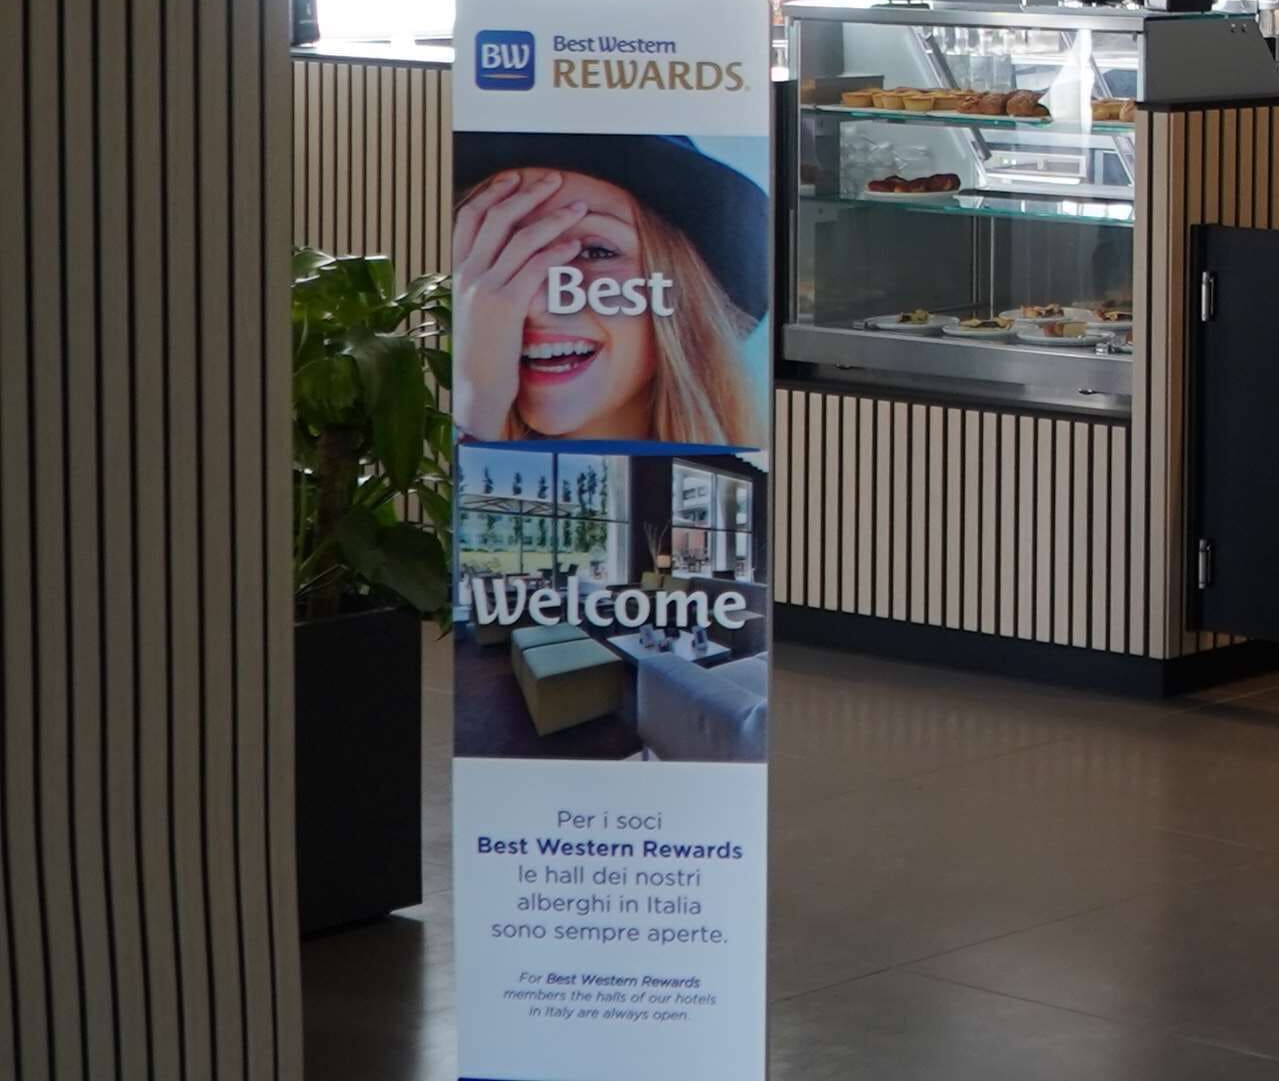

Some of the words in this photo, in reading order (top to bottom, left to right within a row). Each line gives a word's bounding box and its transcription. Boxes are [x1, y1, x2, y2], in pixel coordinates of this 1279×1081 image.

[552, 35, 595, 53] Best
[597, 36, 677, 54] Western
[481, 43, 530, 70] BW
[546, 265, 675, 317] Best
[470, 575, 748, 630] Welcome
[557, 810, 596, 829] Per
[603, 811, 609, 829] i
[617, 811, 662, 831] soci
[478, 836, 528, 855] Best
[536, 838, 633, 857] Western
[643, 840, 743, 860] Rewards
[518, 865, 537, 884] le
[545, 865, 584, 885] hall
[593, 867, 627, 886] dei
[636, 868, 701, 887] nostri
[517, 893, 610, 916] alberghi
[620, 896, 639, 914] in
[647, 896, 702, 916] Italia
[491, 923, 546, 940] sono
[554, 925, 640, 945] sempre
[648, 926, 728, 946] aperte.
[519, 972, 543, 985] For
[546, 973, 577, 986] Best
[581, 973, 638, 987] Western
[641, 975, 701, 989] Rewards
[503, 989, 566, 1002] members
[571, 991, 592, 1002] the
[596, 991, 627, 1003] halls
[630, 992, 646, 1004] of
[648, 995, 672, 1005] our
[675, 994, 717, 1006] hotels
[528, 1006, 541, 1017] in
[545, 1007, 573, 1020] Italy
[577, 1011, 599, 1019] are
[602, 1008, 649, 1021] always
